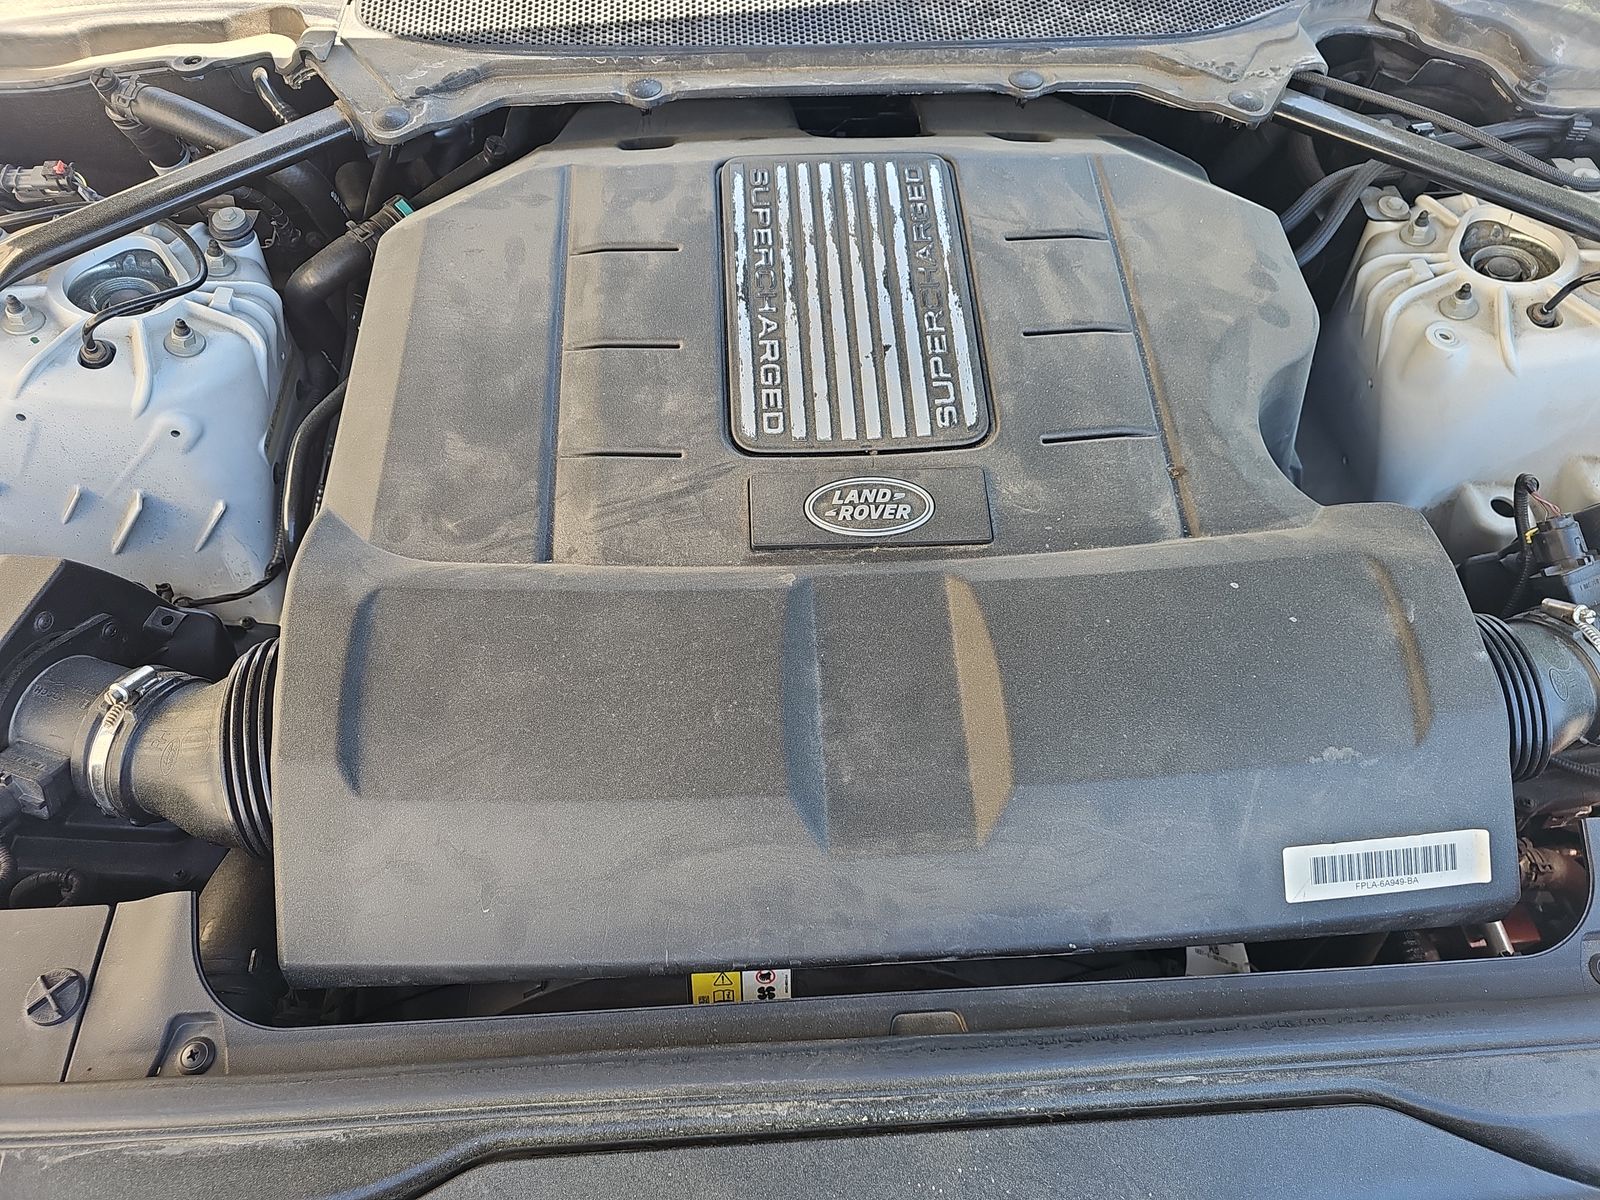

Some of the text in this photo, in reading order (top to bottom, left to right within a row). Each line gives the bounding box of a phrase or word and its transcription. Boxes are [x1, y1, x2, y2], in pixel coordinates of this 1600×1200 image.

[750, 168, 784, 435] SUPERCHARGED
[904, 165, 957, 430] SUPERCHARGED
[832, 488, 892, 504] LAND
[838, 504, 912, 520] ROVER
[1355, 877, 1419, 890] FPLA-6A949-BA
